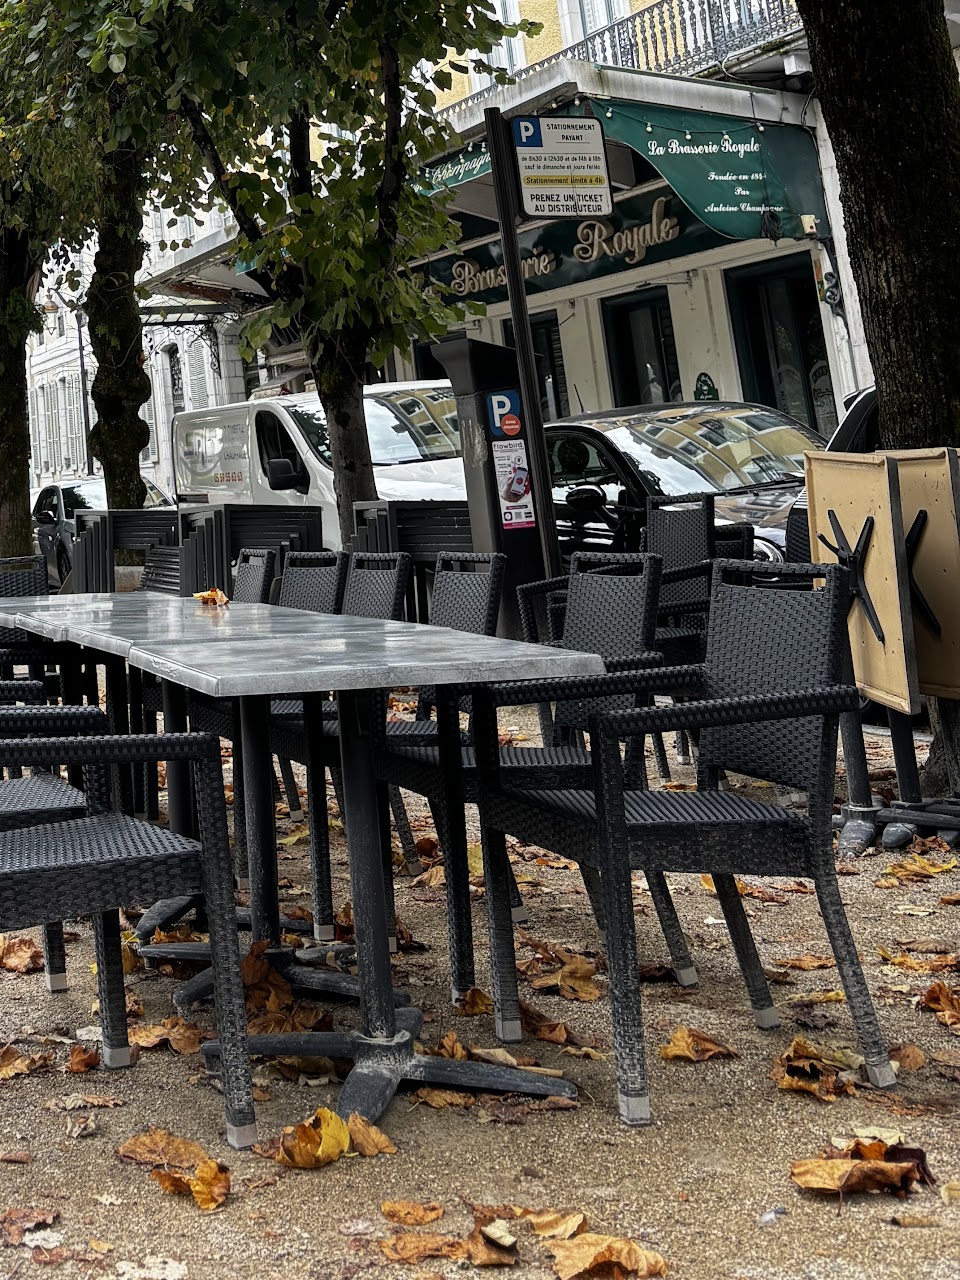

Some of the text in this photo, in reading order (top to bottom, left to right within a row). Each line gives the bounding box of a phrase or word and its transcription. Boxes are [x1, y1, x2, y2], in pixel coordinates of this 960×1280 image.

[520, 121, 534, 143] P
[546, 123, 595, 131] STATIONNEMENT
[647, 136, 760, 159] La Brasserie Royale
[530, 194, 603, 202] PRENEZ UN TICKET
[548, 205, 603, 213] DISTRIBUTEUR
[704, 203, 739, 213] Antoine
[450, 245, 553, 297] Brasrie
[573, 195, 678, 264] Royale
[491, 395, 511, 427] P
[493, 441, 523, 450] flowbird
